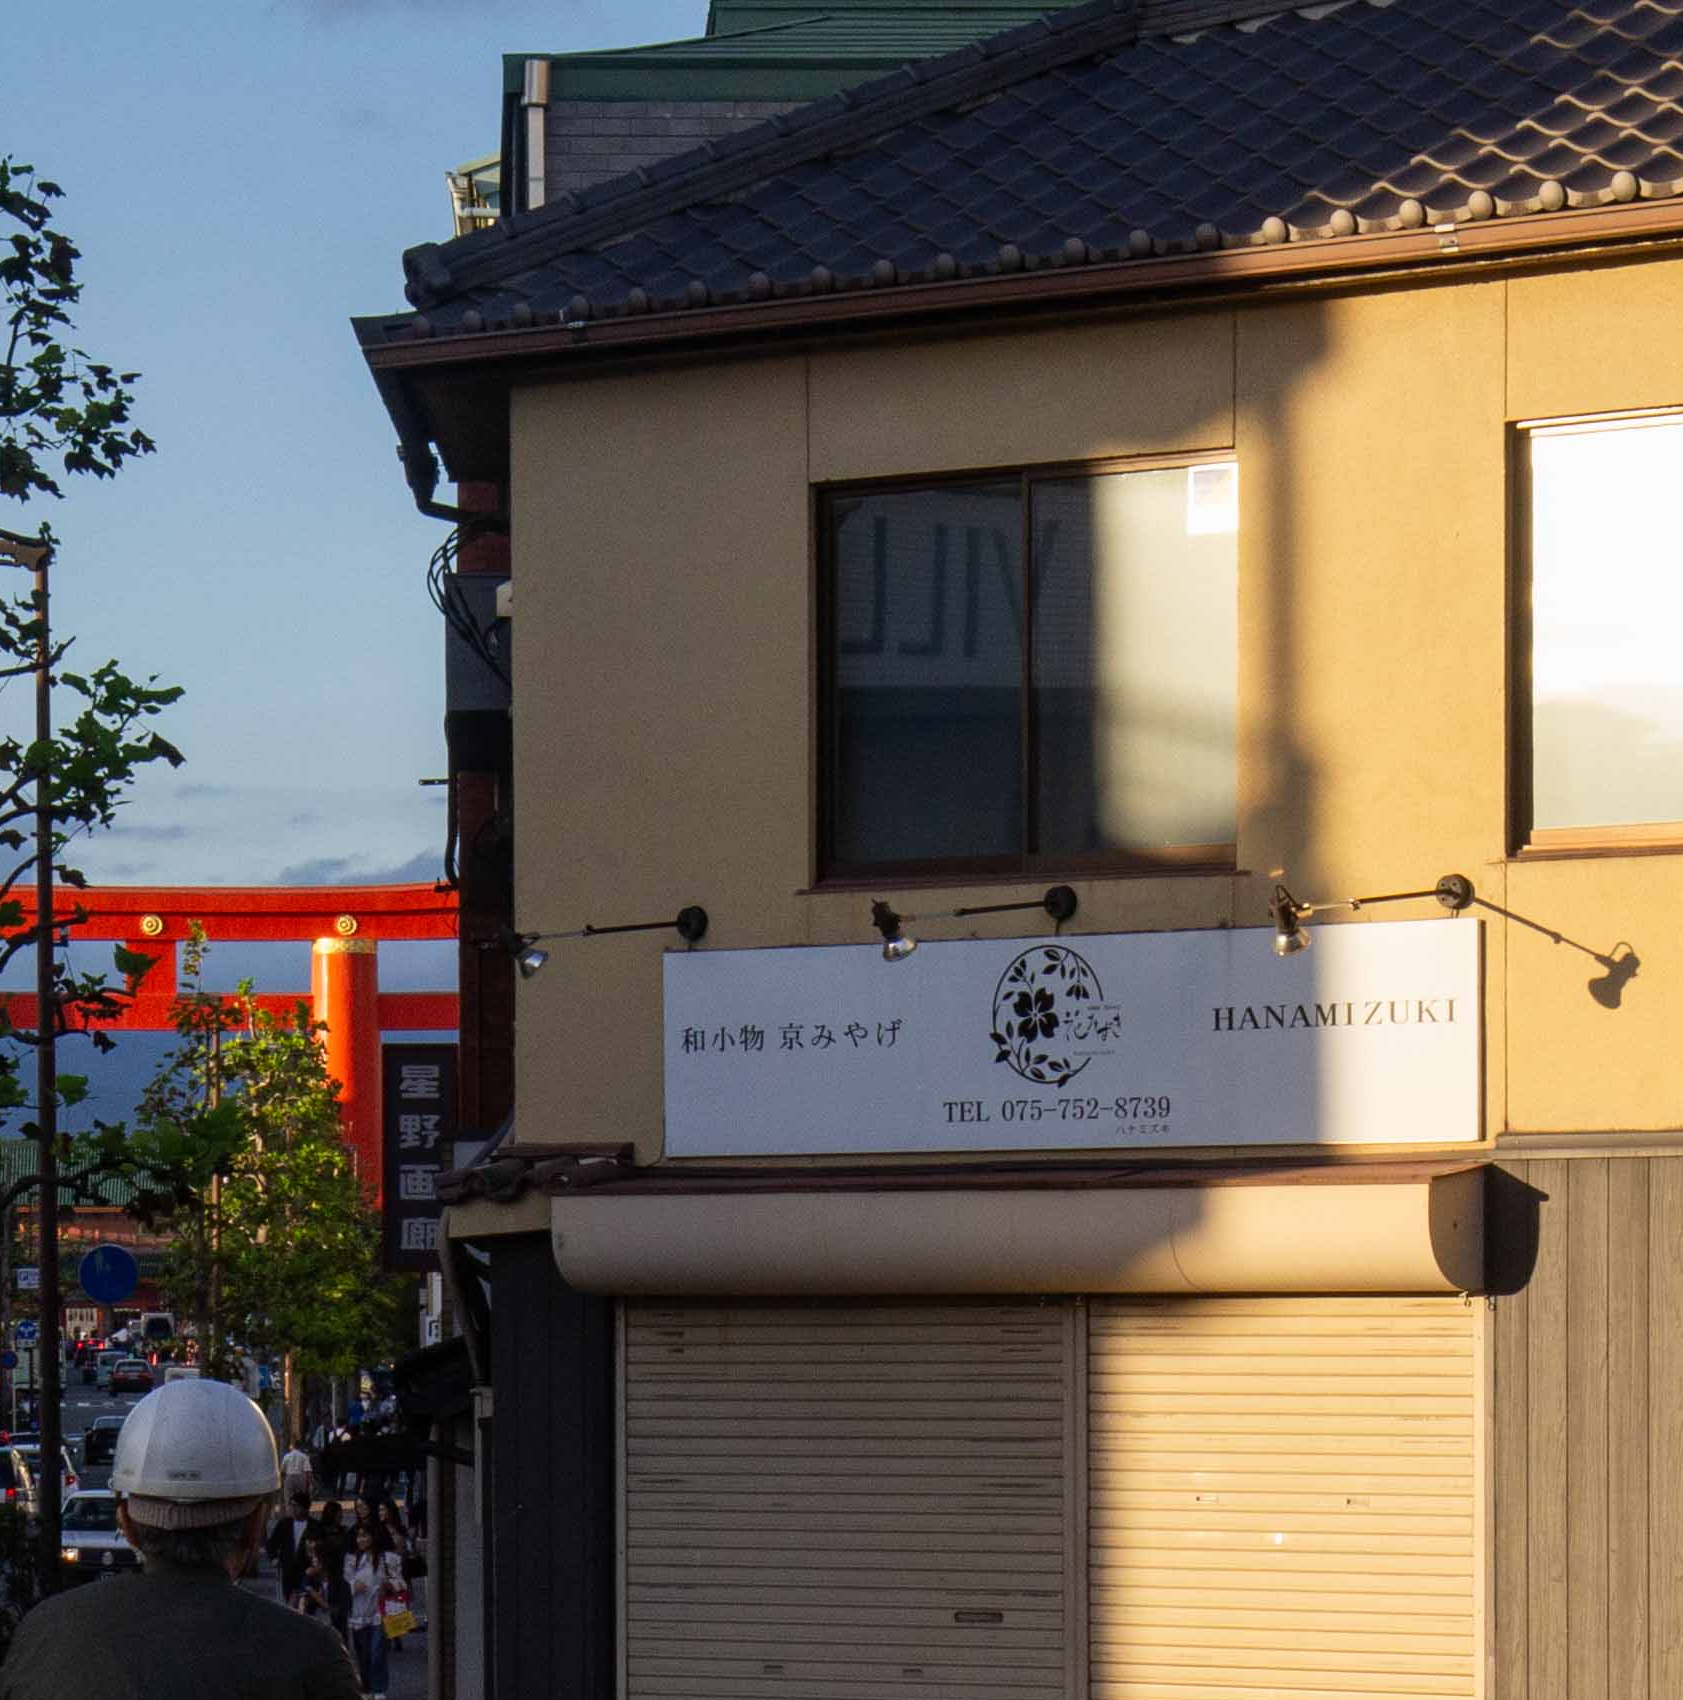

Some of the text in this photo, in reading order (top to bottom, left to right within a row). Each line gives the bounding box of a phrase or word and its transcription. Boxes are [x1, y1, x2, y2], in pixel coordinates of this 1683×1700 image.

[1212, 998, 1457, 1032] HANAMIZUKI
[680, 1018, 903, 1054] 和小物 京みやげ
[943, 1096, 1171, 1123] TEL 075-752-8739
